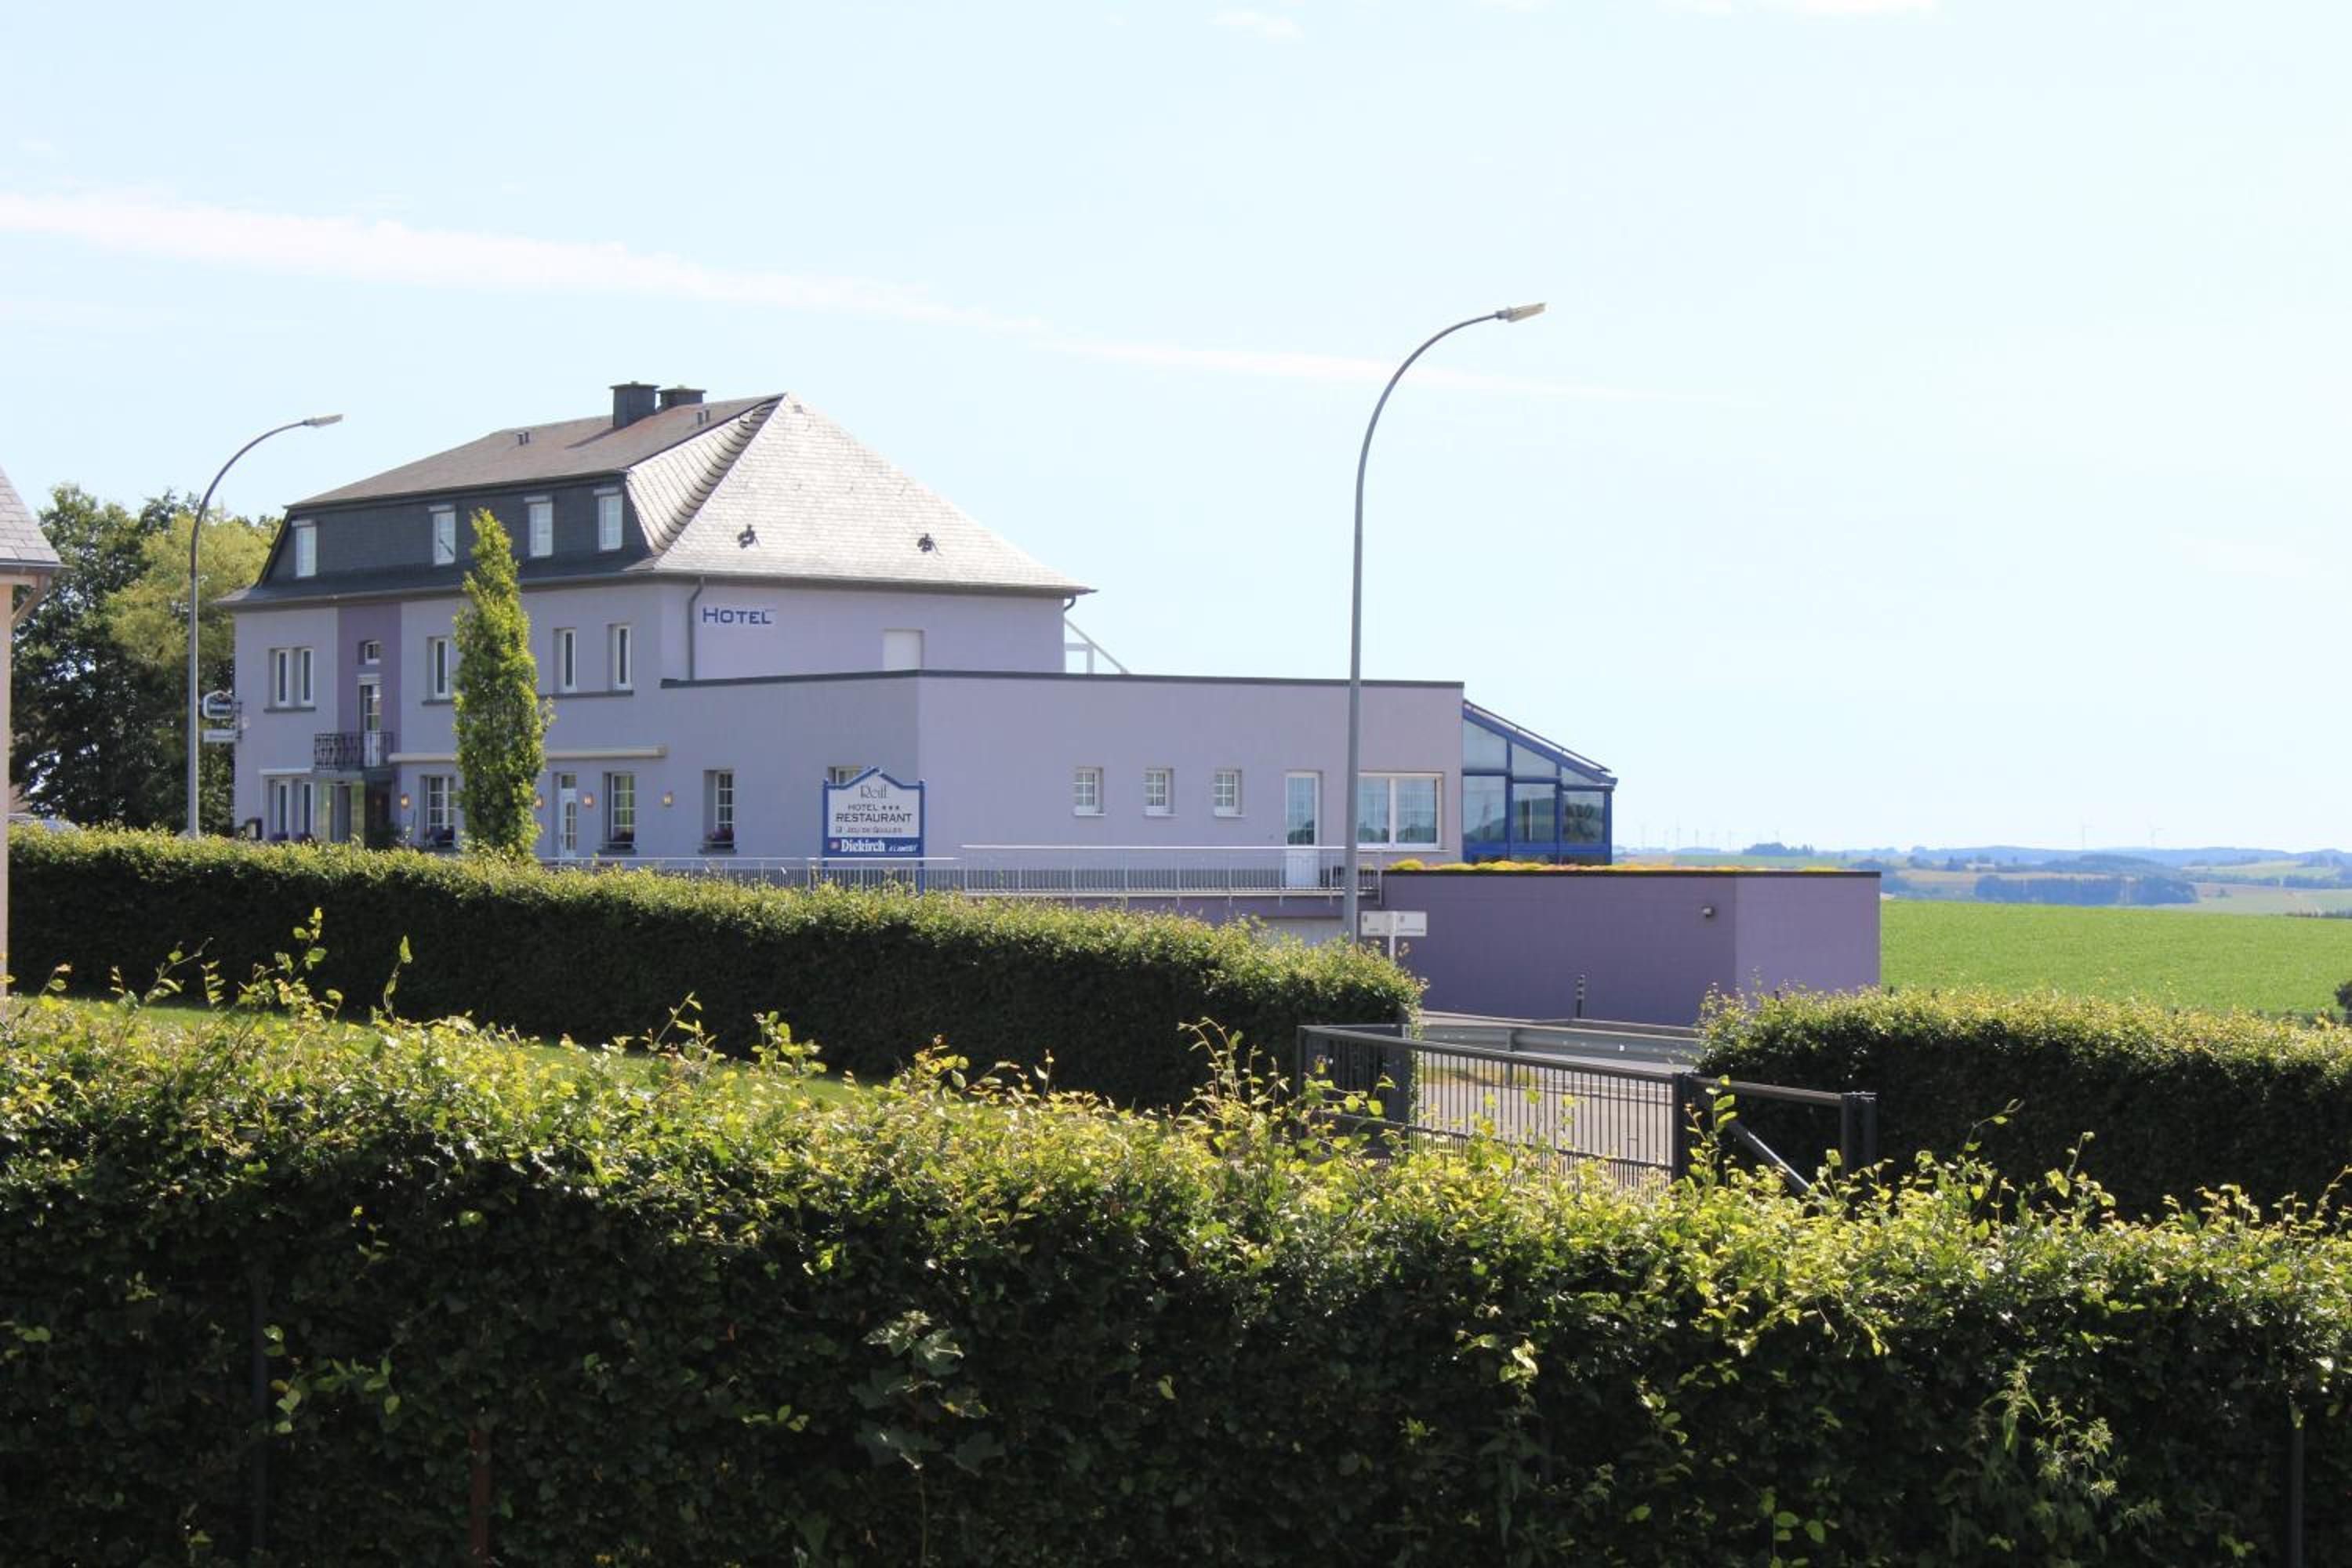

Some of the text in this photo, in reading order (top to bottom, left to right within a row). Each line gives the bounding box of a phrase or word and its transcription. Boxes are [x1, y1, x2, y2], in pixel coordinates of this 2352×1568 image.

[702, 607, 773, 625] HOTEL
[835, 813, 913, 822] RESTAURANT
[840, 839, 885, 852] Diekirch
